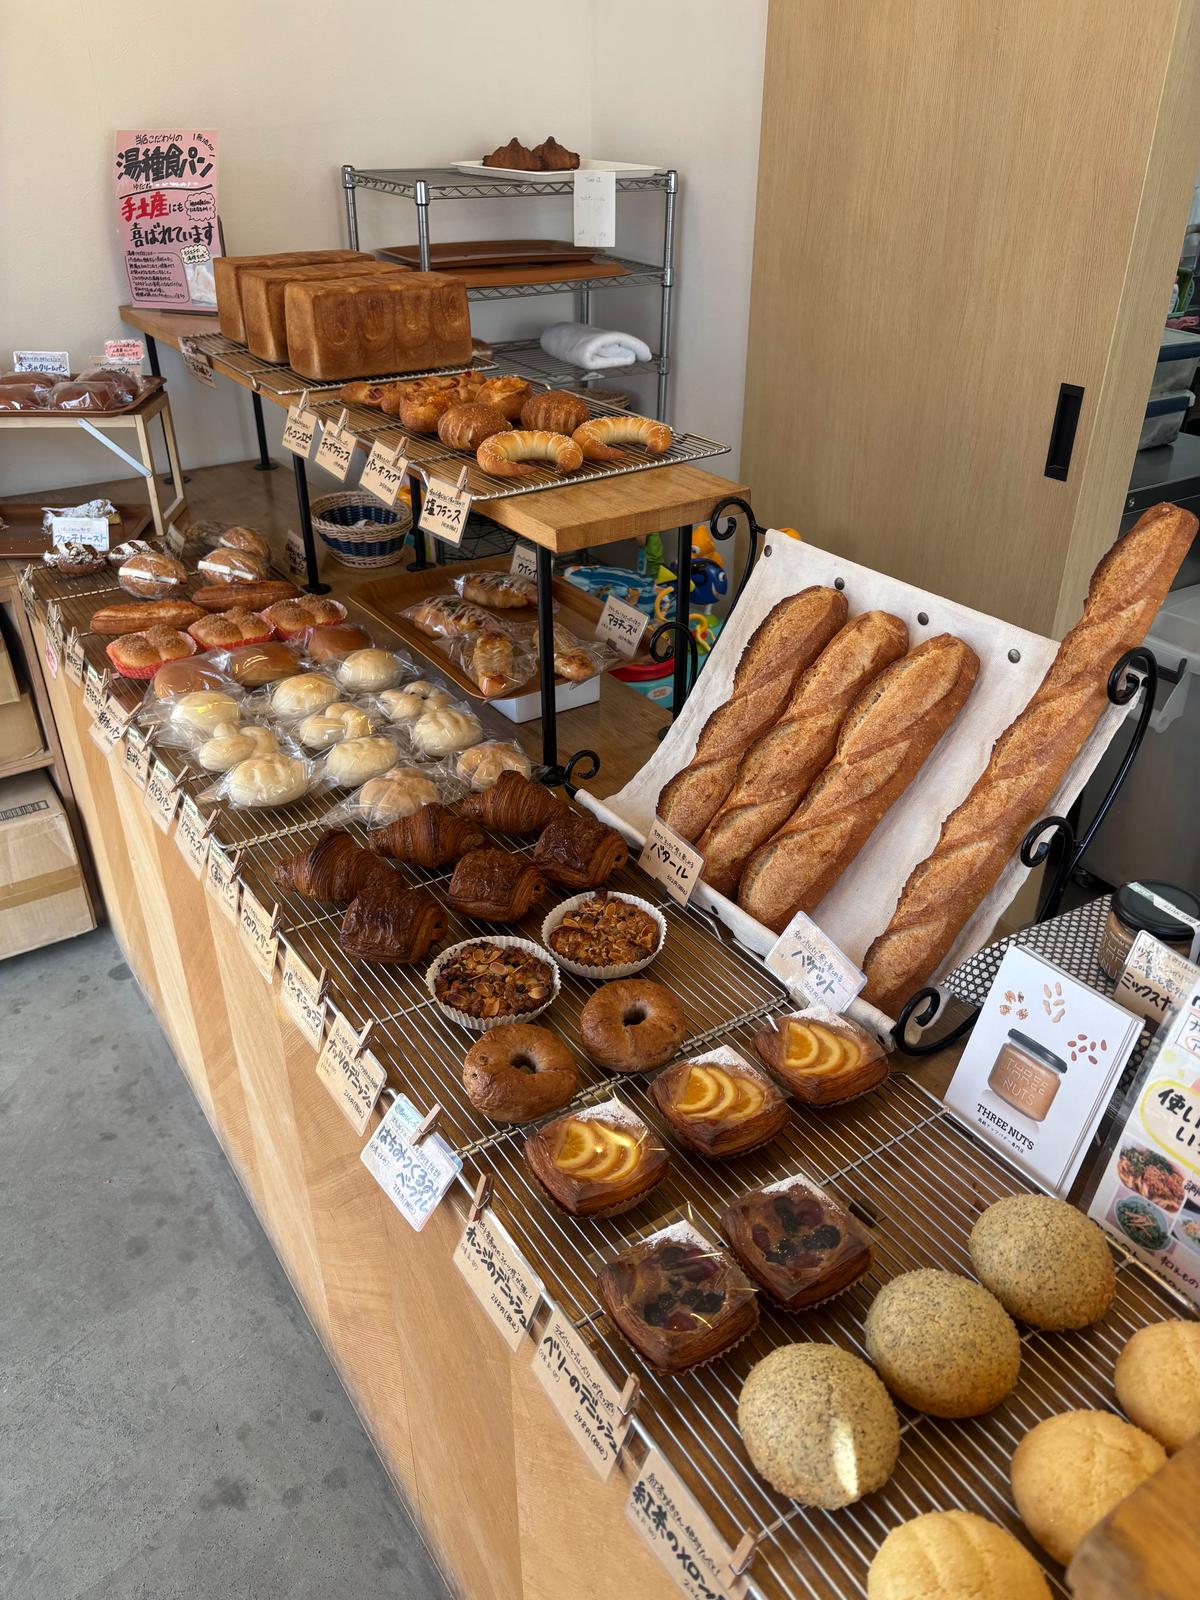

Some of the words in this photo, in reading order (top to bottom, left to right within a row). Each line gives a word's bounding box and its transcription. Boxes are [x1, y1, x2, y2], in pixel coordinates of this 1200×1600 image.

[116, 143, 214, 182] 湯種食パン
[121, 191, 183, 222] 手土産にも
[130, 222, 214, 247] 喜ばれています
[424, 498, 462, 524] 塩フランス
[55, 534, 107, 544] フレンチトースト
[607, 613, 638, 636] マヨチーズ
[649, 842, 689, 880] バタール
[243, 908, 272, 955] クロワッサン
[791, 950, 836, 994] バゲット
[328, 1039, 373, 1110] ナッツのデニッシュ
[1002, 1078, 1035, 1107] NUTS
[1005, 1057, 1049, 1097] THREE
[976, 1103, 1007, 1131] THREE
[1008, 1126, 1035, 1151] NUTS
[376, 1125, 440, 1200] はちみつくるみ
[395, 1172, 429, 1213] ベーグル
[465, 1224, 530, 1330] オレンジのデニッシュ
[542, 1335, 619, 1456] ベリーのデニッシュ
[573, 1410, 609, 1462] 248円(税込)
